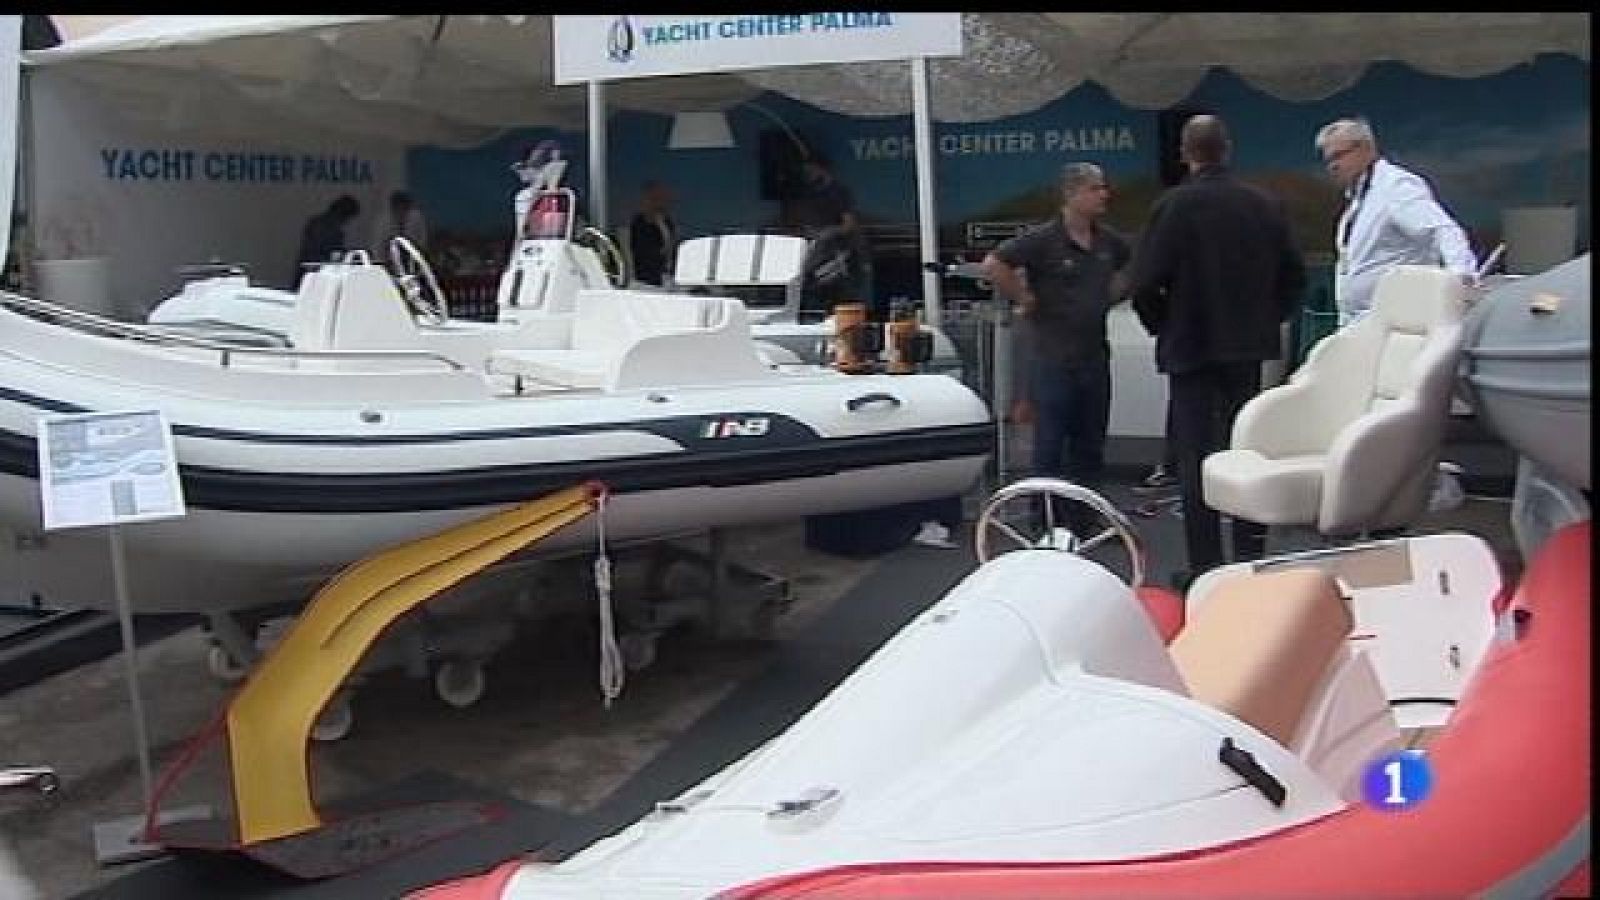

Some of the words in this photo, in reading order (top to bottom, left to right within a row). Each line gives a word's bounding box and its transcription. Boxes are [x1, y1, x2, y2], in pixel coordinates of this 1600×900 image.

[643, 22, 711, 46] YACHT
[719, 15, 801, 39] CENTER
[812, 12, 893, 32] PALMA
[850, 136, 916, 160] YACH
[939, 133, 1036, 155] CENTER
[1044, 126, 1137, 152] PALMA
[100, 149, 195, 181] YACHT
[204, 152, 294, 183] CENTER
[302, 154, 373, 184] PALMA
